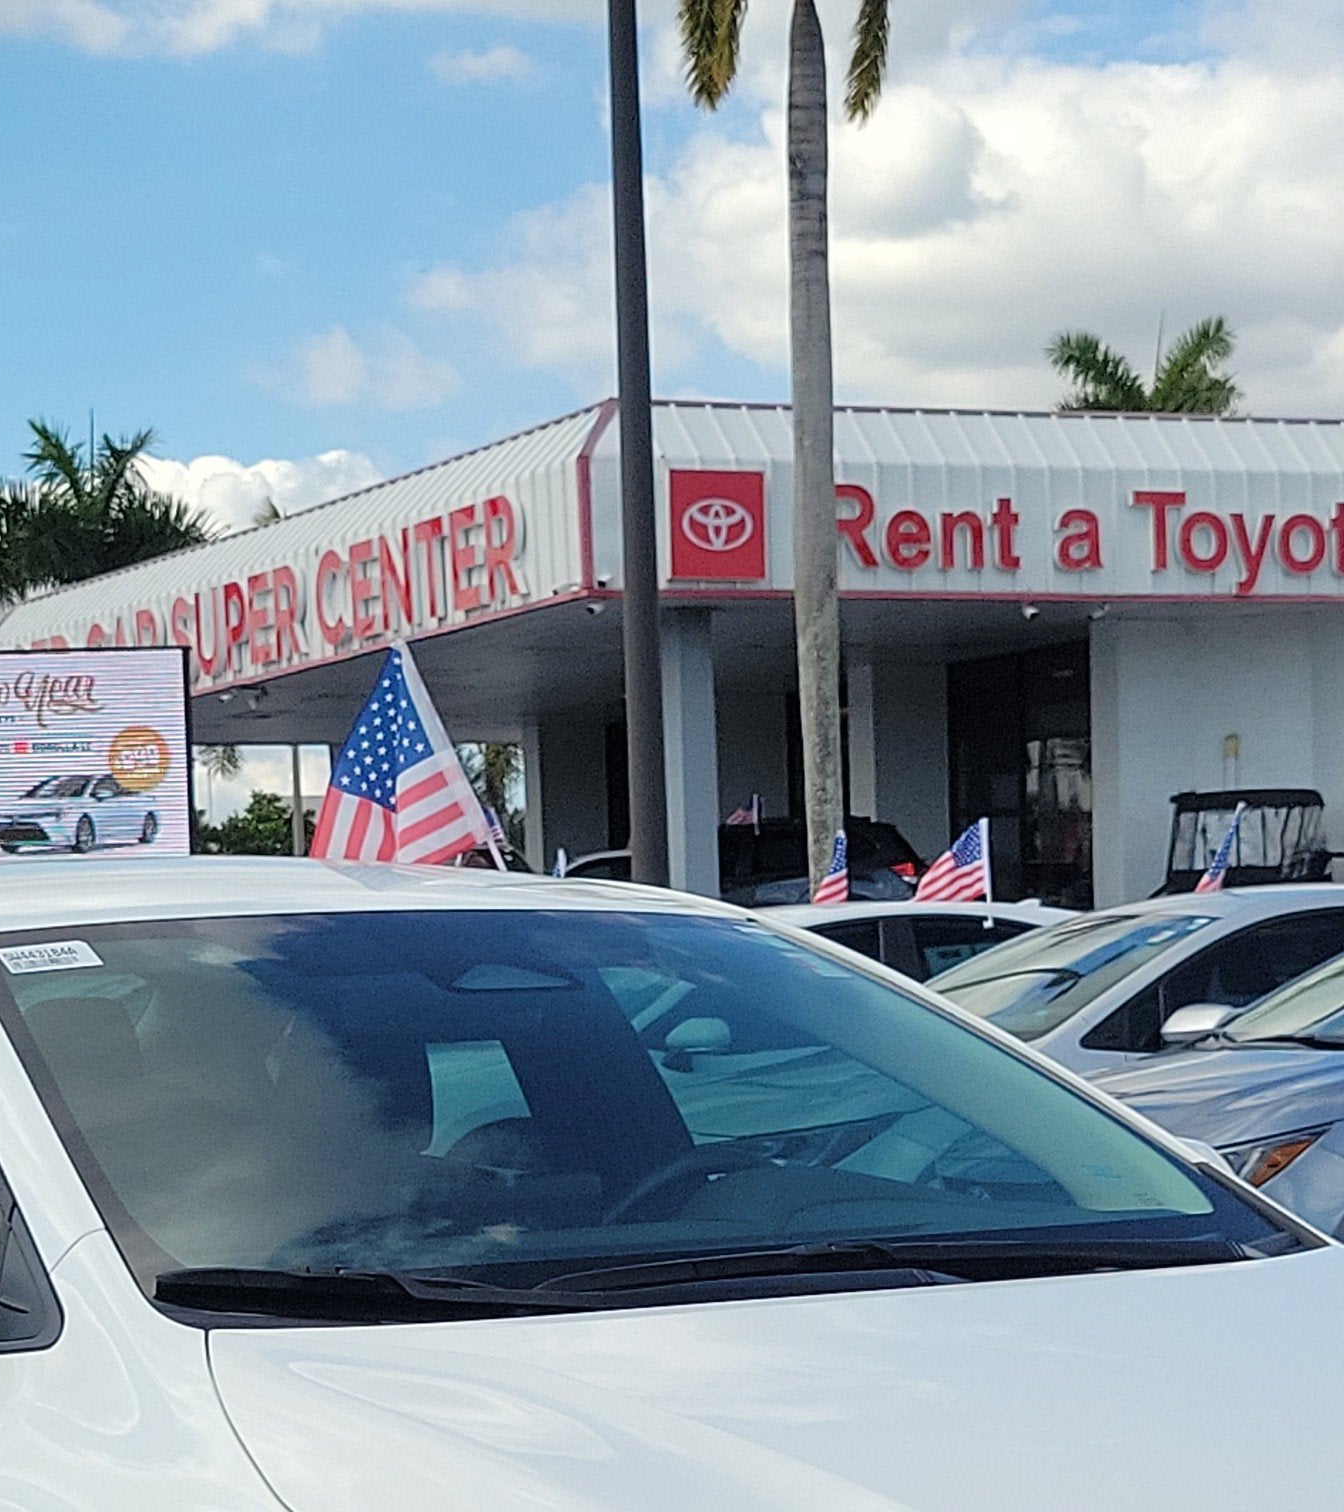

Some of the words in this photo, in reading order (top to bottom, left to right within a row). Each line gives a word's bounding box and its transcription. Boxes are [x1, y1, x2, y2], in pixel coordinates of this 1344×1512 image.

[835, 484, 1020, 570] Rent
[1057, 508, 1103, 570] a
[315, 495, 521, 646] CENTER
[13, 671, 103, 728] Year
